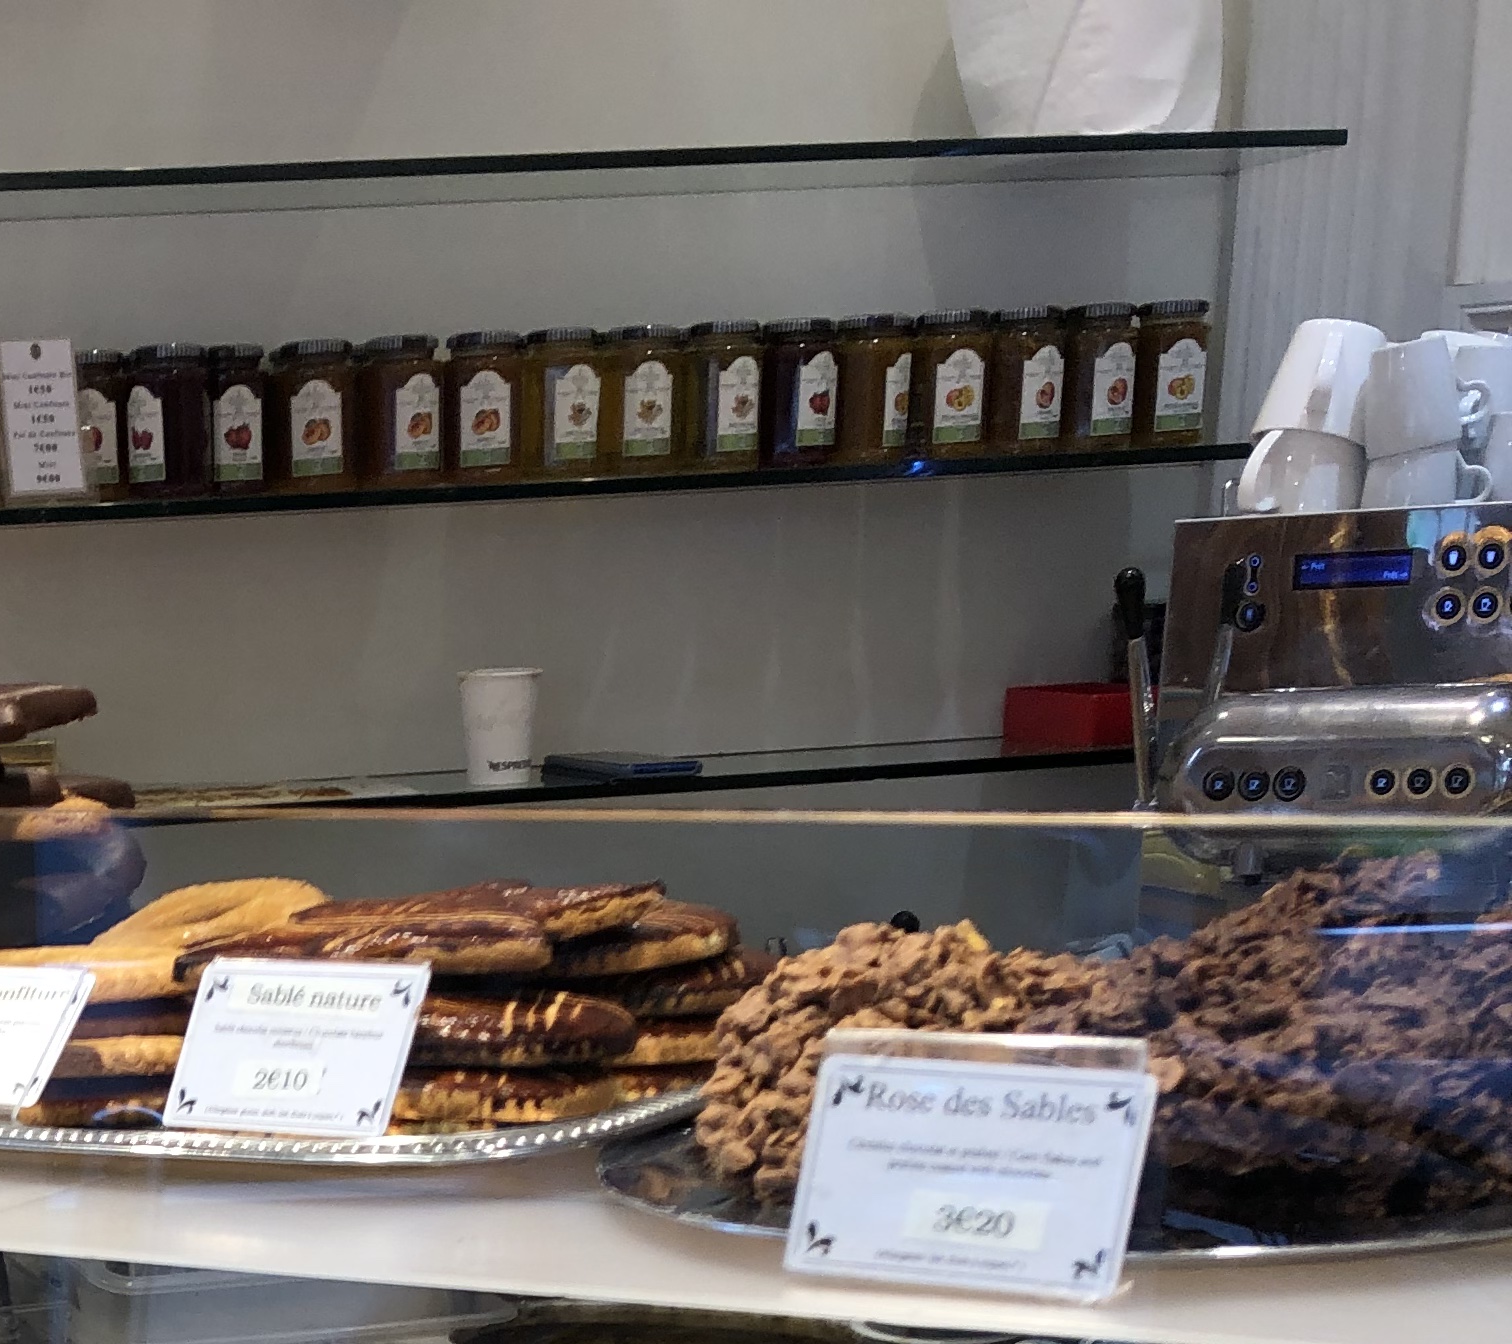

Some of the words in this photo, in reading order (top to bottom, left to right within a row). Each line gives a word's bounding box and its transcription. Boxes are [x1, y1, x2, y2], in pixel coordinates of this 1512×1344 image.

[247, 984, 304, 1006] Sablé
[309, 991, 381, 1010] nature
[252, 1069, 308, 1090] 2€10
[864, 1080, 934, 1114] Rose
[943, 1086, 991, 1117] des
[1002, 1090, 1097, 1125] Sables
